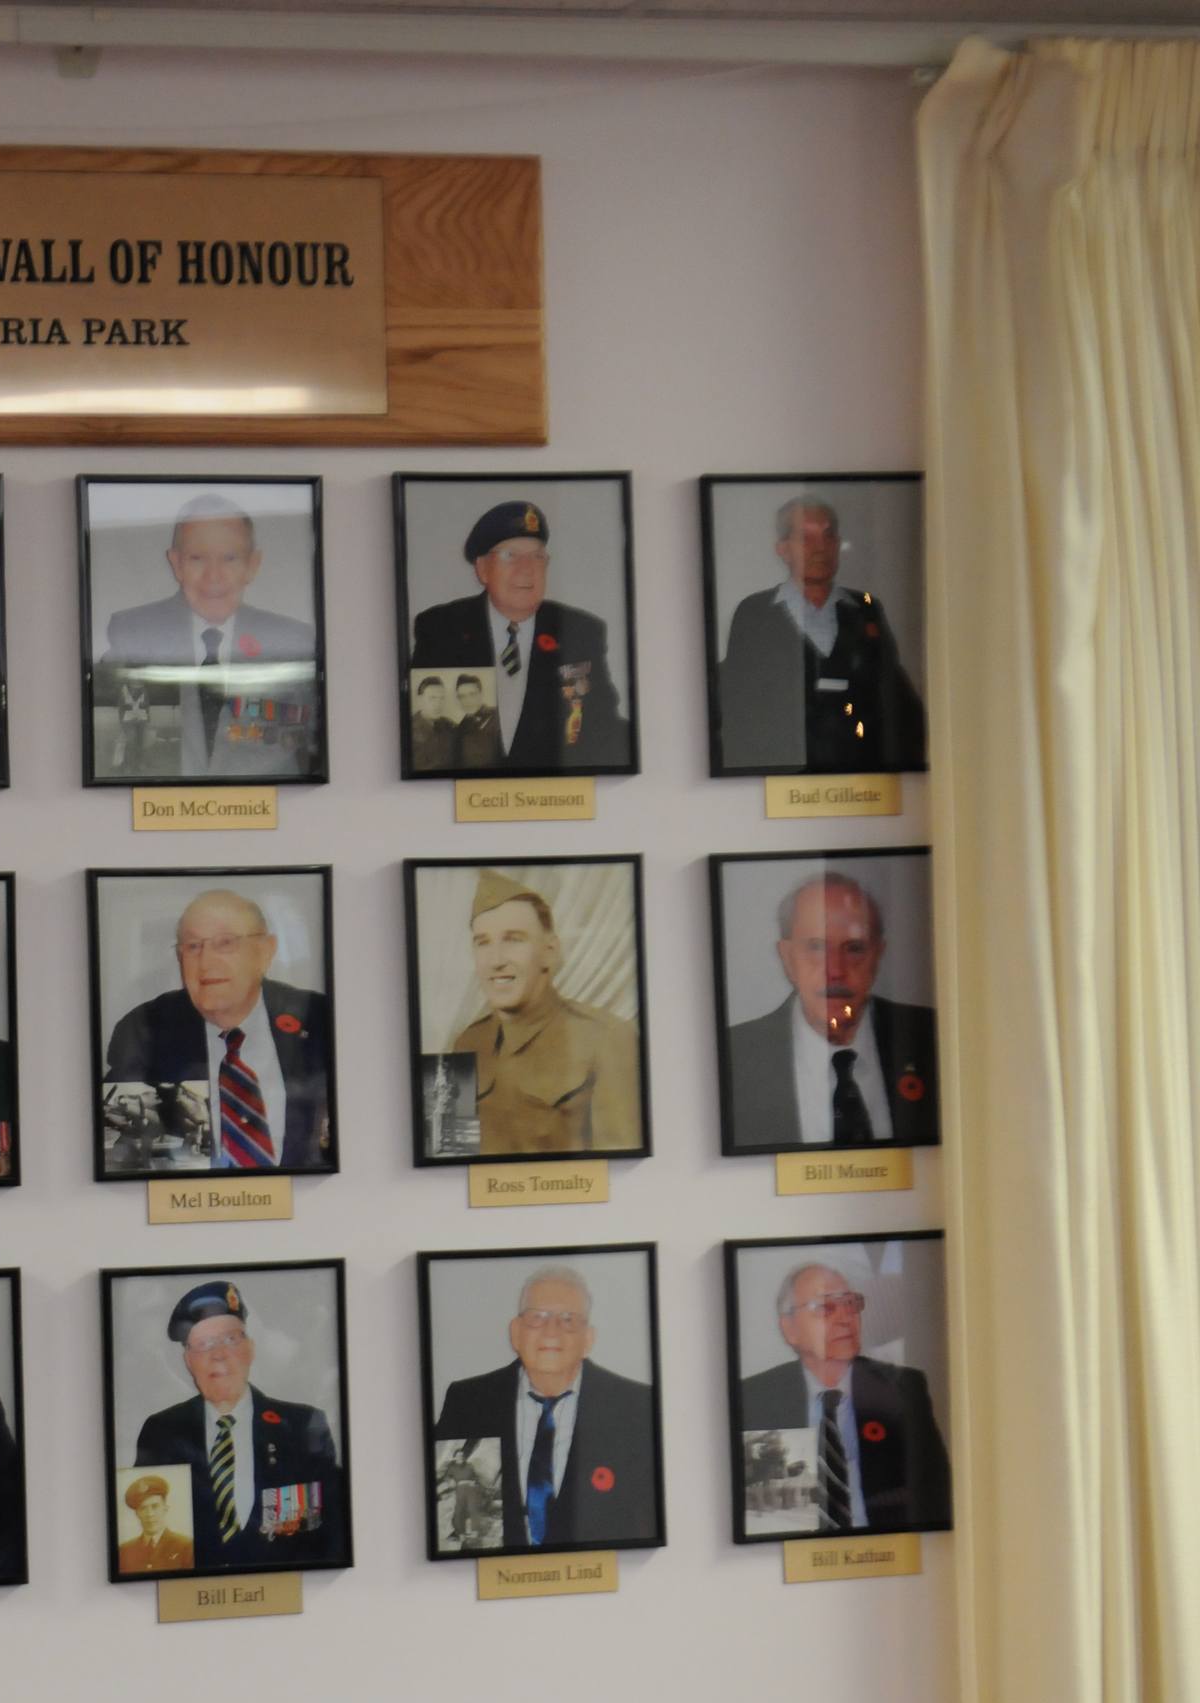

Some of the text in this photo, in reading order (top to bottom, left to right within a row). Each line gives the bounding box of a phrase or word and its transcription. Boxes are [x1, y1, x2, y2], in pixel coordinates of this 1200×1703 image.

[108, 239, 163, 284] OF
[177, 241, 354, 287] HONOUR
[82, 318, 190, 347] PARK
[468, 792, 584, 808] Cecil Swanson
[789, 787, 881, 804] Bud Gillette
[142, 800, 270, 817] Don McCormick
[805, 1165, 833, 1180] Bill
[488, 1175, 593, 1193] Ross Tomalty
[171, 1191, 271, 1209] Mel Boulton
[812, 1551, 838, 1567] Bill
[498, 1564, 602, 1584] Norman Lind
[197, 1587, 264, 1606] Bill Earl
